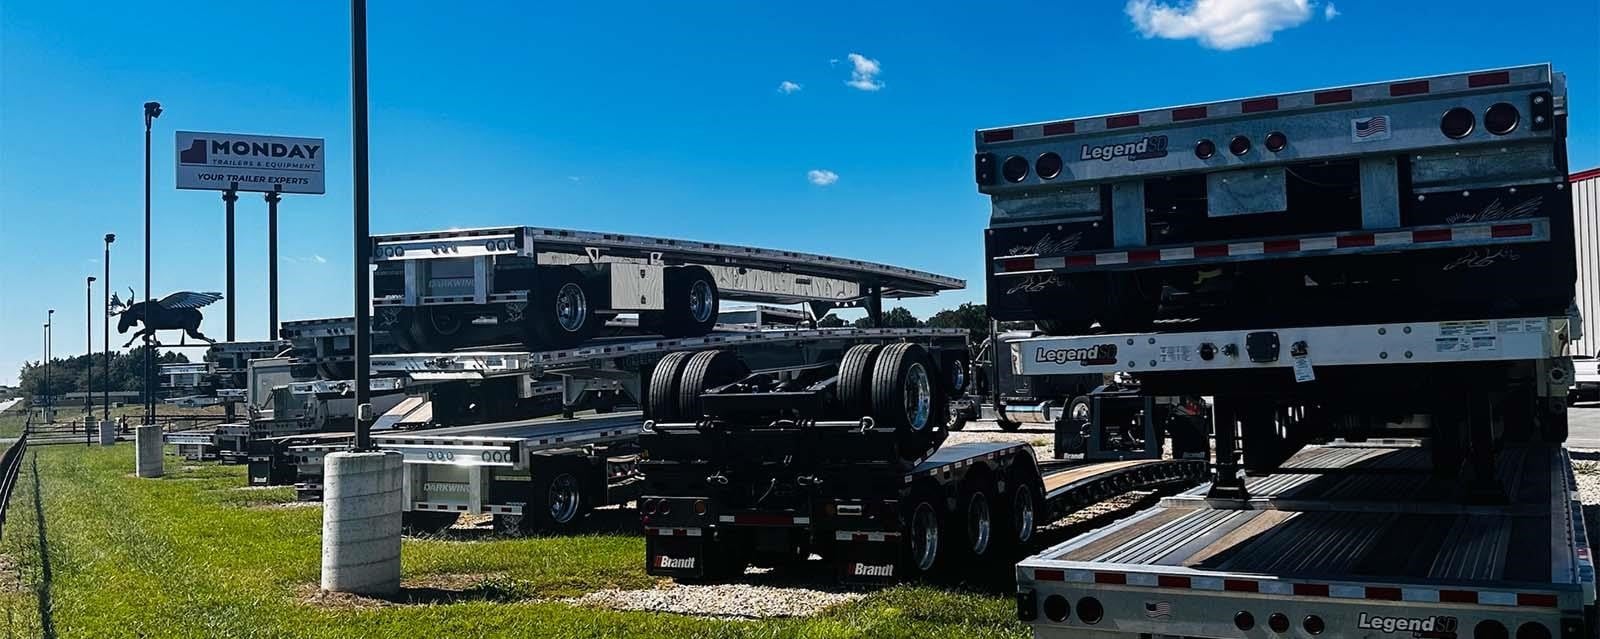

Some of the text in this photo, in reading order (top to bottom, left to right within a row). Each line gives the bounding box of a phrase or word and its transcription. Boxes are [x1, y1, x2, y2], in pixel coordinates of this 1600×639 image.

[212, 140, 320, 159] MONDAY
[212, 159, 253, 167] TRAILERS
[198, 173, 309, 185] YOUR TRAILER EXPERTS
[428, 279, 474, 289] DARKWIN
[660, 555, 696, 569] Brandt
[854, 562, 894, 577] Brandt
